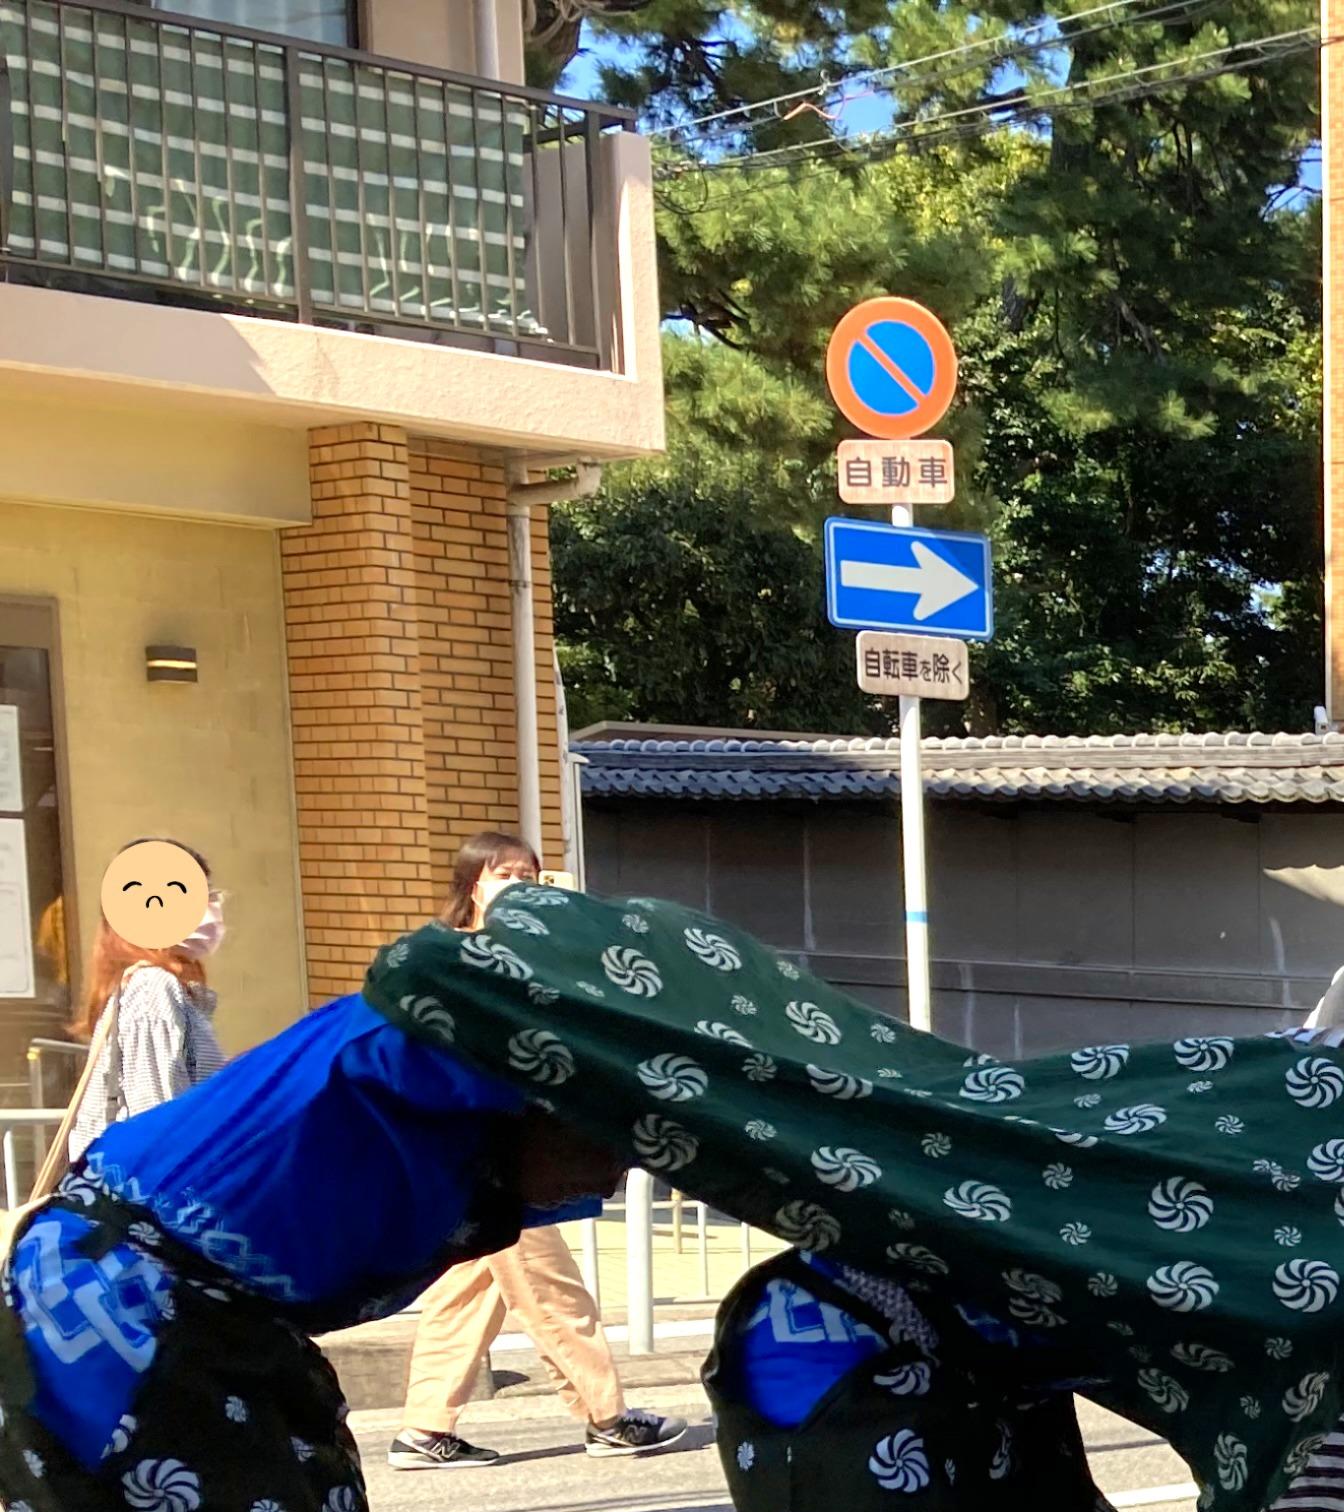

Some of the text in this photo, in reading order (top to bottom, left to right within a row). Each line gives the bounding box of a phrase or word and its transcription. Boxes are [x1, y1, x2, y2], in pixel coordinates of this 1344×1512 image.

[845, 456, 948, 488] 自動車
[863, 648, 964, 685] 自転車を除く
